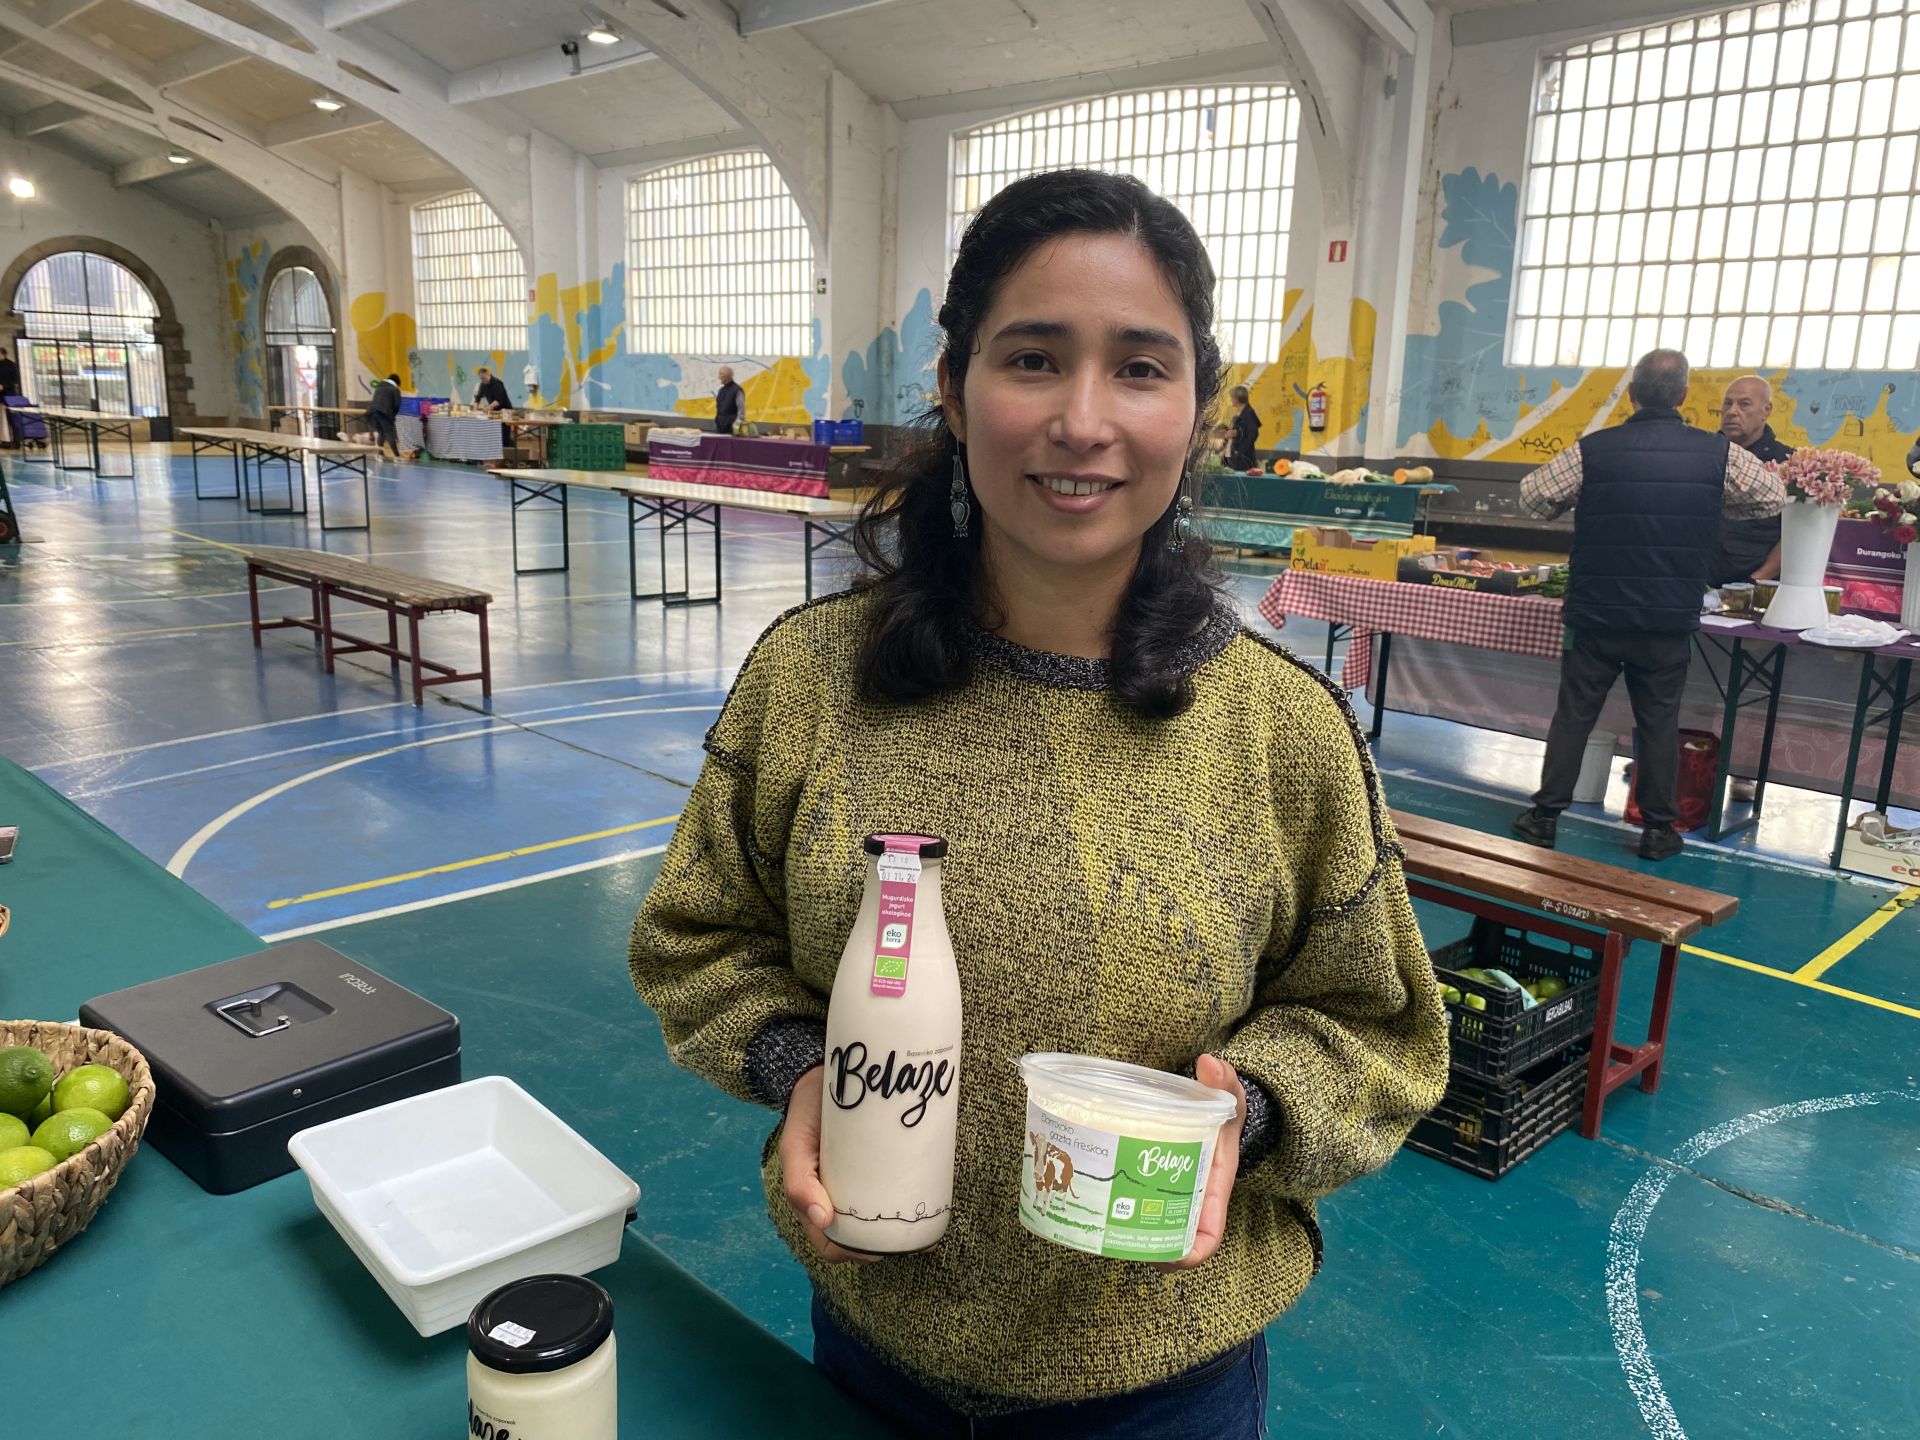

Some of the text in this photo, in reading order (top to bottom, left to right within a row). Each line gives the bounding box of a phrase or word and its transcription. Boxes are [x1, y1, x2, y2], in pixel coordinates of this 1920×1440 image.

[1856, 547, 1902, 559] Durangoko
[886, 929, 902, 937] eko
[829, 1041, 955, 1128] Belaze
[1073, 1138, 1109, 1157] freskoa
[1137, 1146, 1194, 1184] Belaze
[1116, 1202, 1131, 1210] eko
